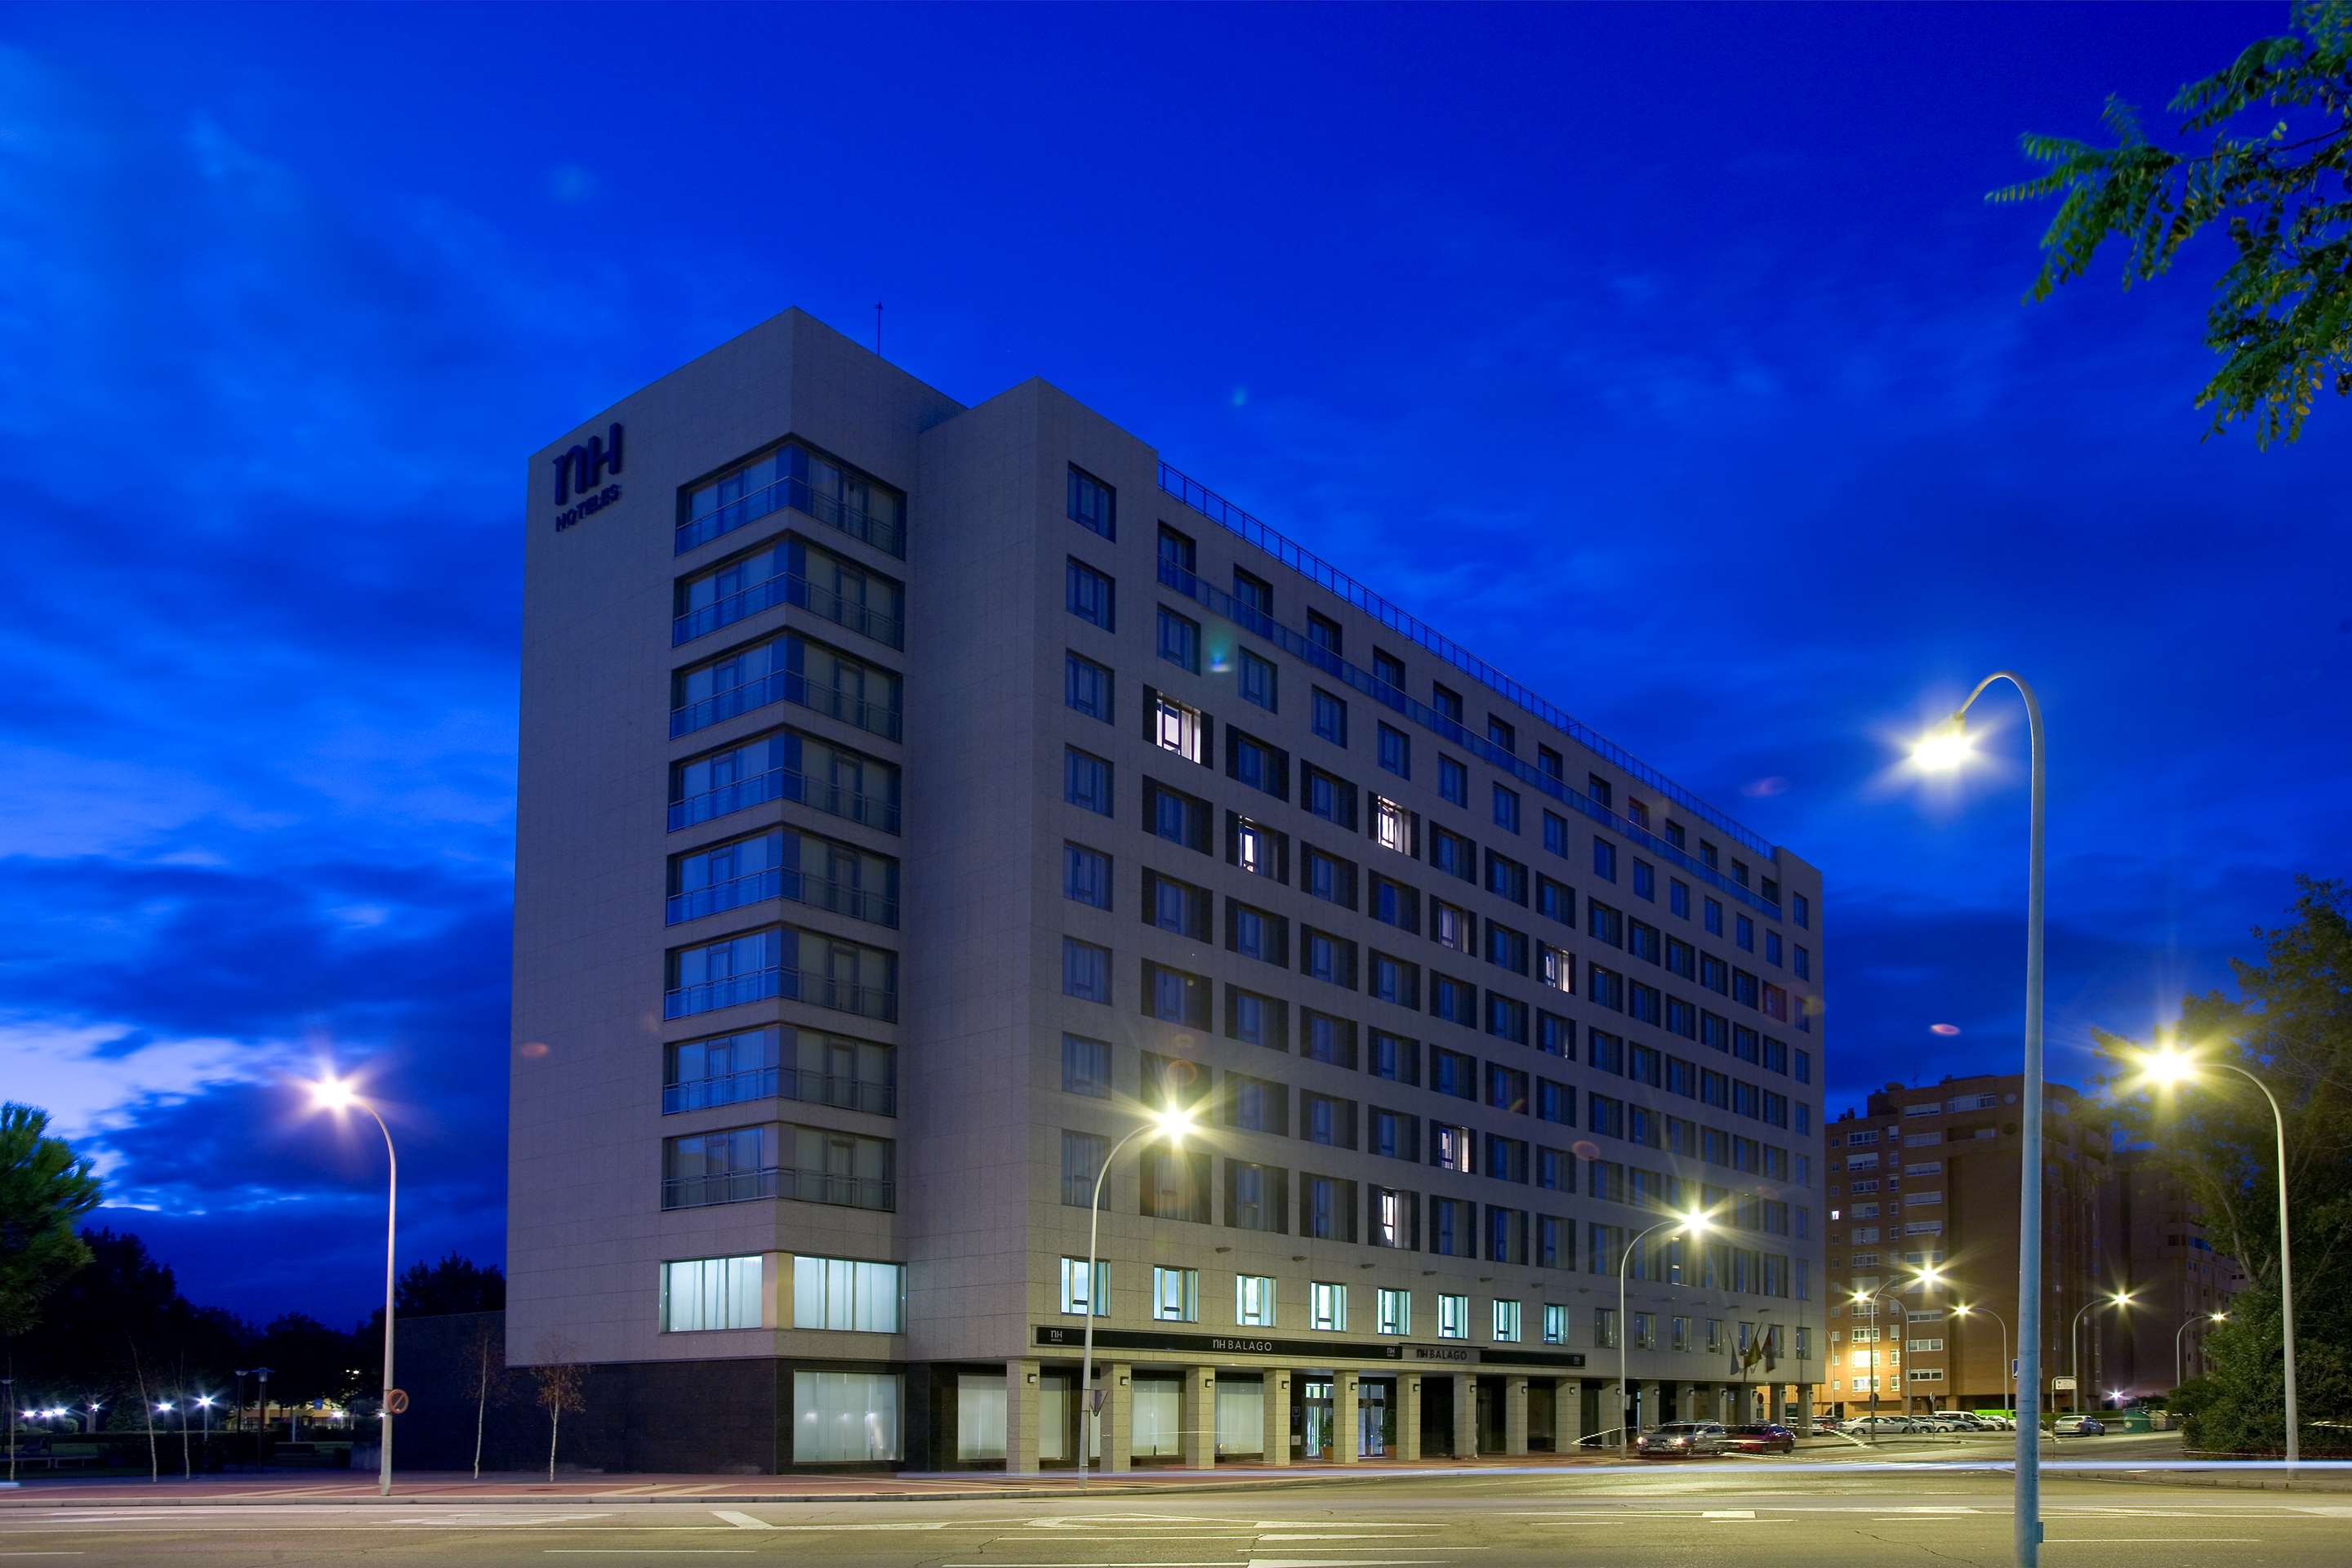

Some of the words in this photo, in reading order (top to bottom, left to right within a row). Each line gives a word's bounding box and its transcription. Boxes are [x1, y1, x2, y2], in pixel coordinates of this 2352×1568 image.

[555, 483, 621, 532] HOTELES
[1227, 1340, 1272, 1352] BALAGO
[1430, 1349, 1468, 1360] BALAGO
